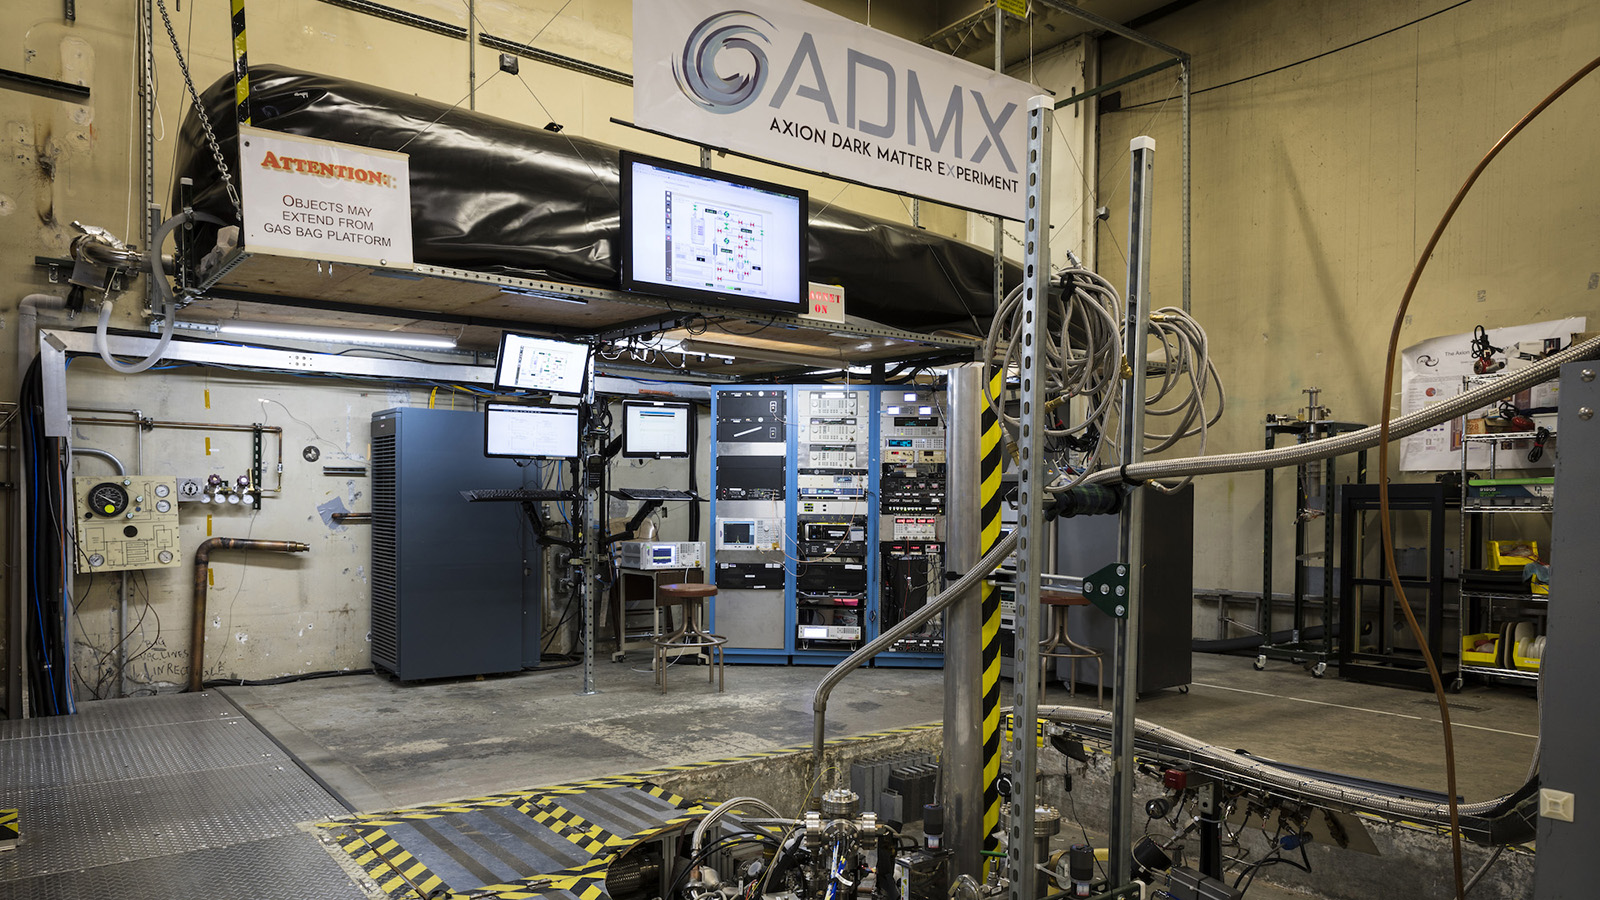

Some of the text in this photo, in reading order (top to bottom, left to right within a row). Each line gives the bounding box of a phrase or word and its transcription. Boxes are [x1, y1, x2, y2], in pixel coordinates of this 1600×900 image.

[768, 31, 1019, 174] ADMX
[769, 117, 1019, 194] AXION DARK MATTER EXPERIMENT
[260, 150, 391, 187] ATTENTION:
[282, 194, 373, 218] OBJECTS MAY
[282, 211, 374, 231] EXTEND FROM
[263, 222, 392, 247] GAS BAG PLATFORM
[809, 290, 842, 304] AGNET
[814, 303, 828, 314] ON
[153, 664, 165, 676] IN
